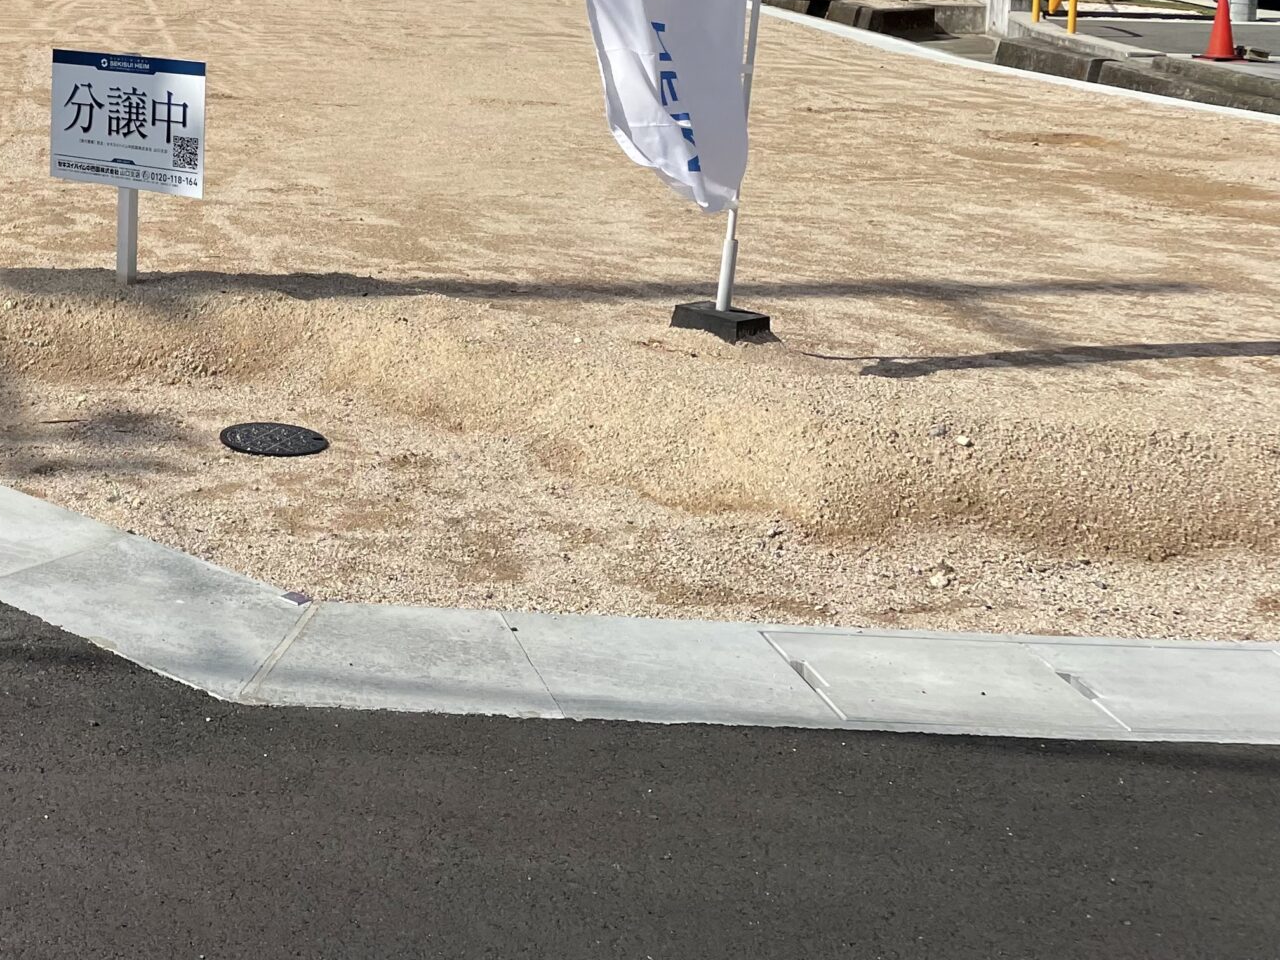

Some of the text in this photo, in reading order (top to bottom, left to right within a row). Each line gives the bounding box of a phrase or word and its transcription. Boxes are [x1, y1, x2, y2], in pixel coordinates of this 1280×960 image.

[109, 60, 134, 68] SEKISUI
[134, 62, 150, 70] HEIM
[63, 82, 189, 144] 分譲中
[150, 171, 198, 187] 0120-118-164
